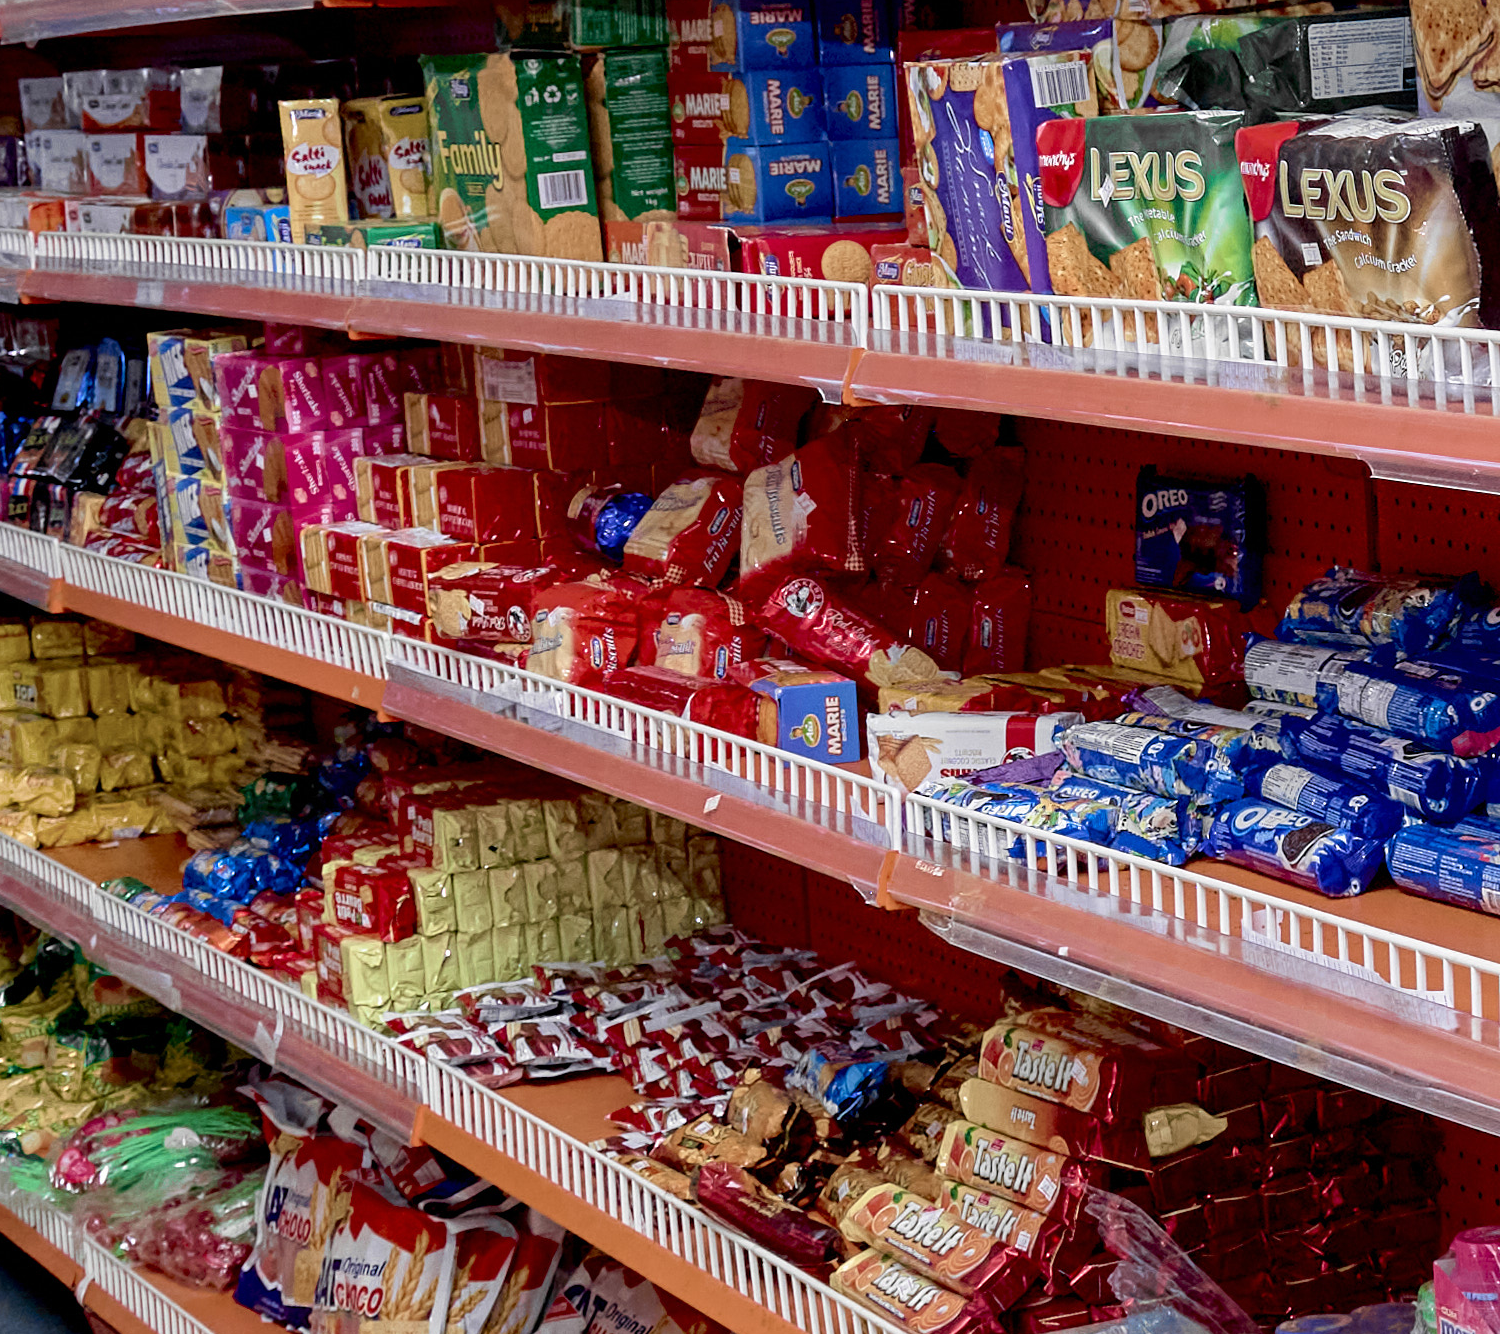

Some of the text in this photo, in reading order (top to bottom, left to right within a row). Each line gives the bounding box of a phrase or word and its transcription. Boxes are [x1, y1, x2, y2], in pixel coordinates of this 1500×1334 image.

[686, 93, 721, 116] MARIE
[767, 78, 785, 135] MARIE
[866, 75, 880, 130] MARIE
[291, 147, 325, 164] Salti
[393, 141, 426, 159] Salti
[437, 131, 504, 191] Family
[690, 167, 727, 190] MARIE
[769, 159, 822, 176] MARIE
[1090, 147, 1206, 202] LEXUS
[1279, 159, 1411, 224] LEXUS
[1323, 229, 1372, 251] The Sandwich
[1354, 252, 1418, 273] Calcium Cracker
[1140, 488, 1189, 518] OREO
